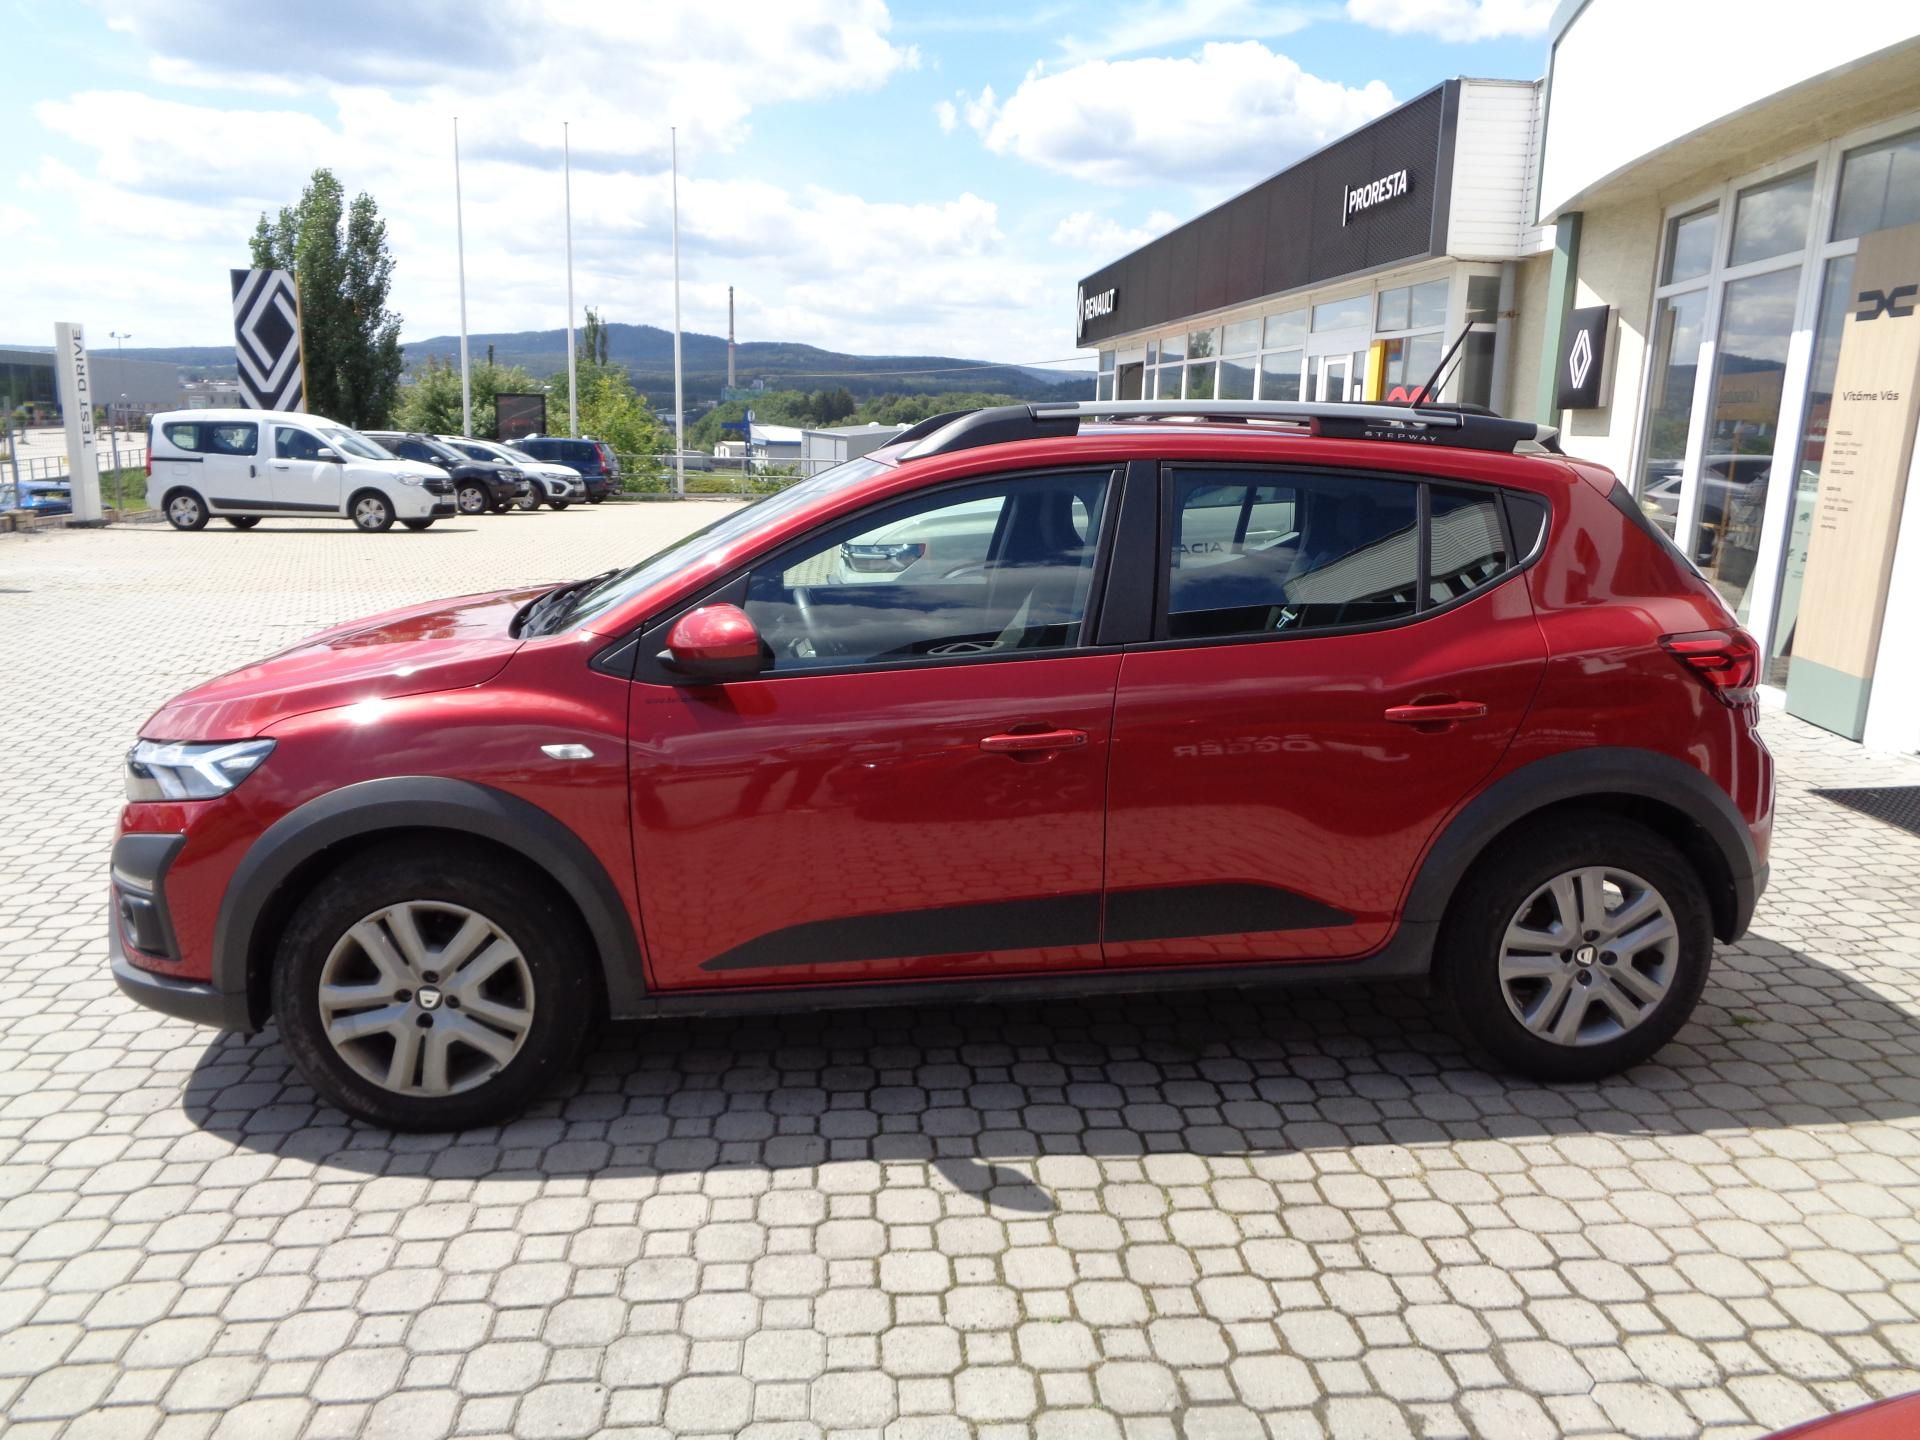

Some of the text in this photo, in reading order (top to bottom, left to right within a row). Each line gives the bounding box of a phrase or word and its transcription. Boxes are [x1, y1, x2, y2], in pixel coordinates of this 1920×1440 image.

[1348, 169, 1407, 214] PRORESTA
[1084, 288, 1115, 321] RENAULT
[72, 328, 92, 448] TEST DRIVE
[1364, 431, 1437, 442] STEPWAY
